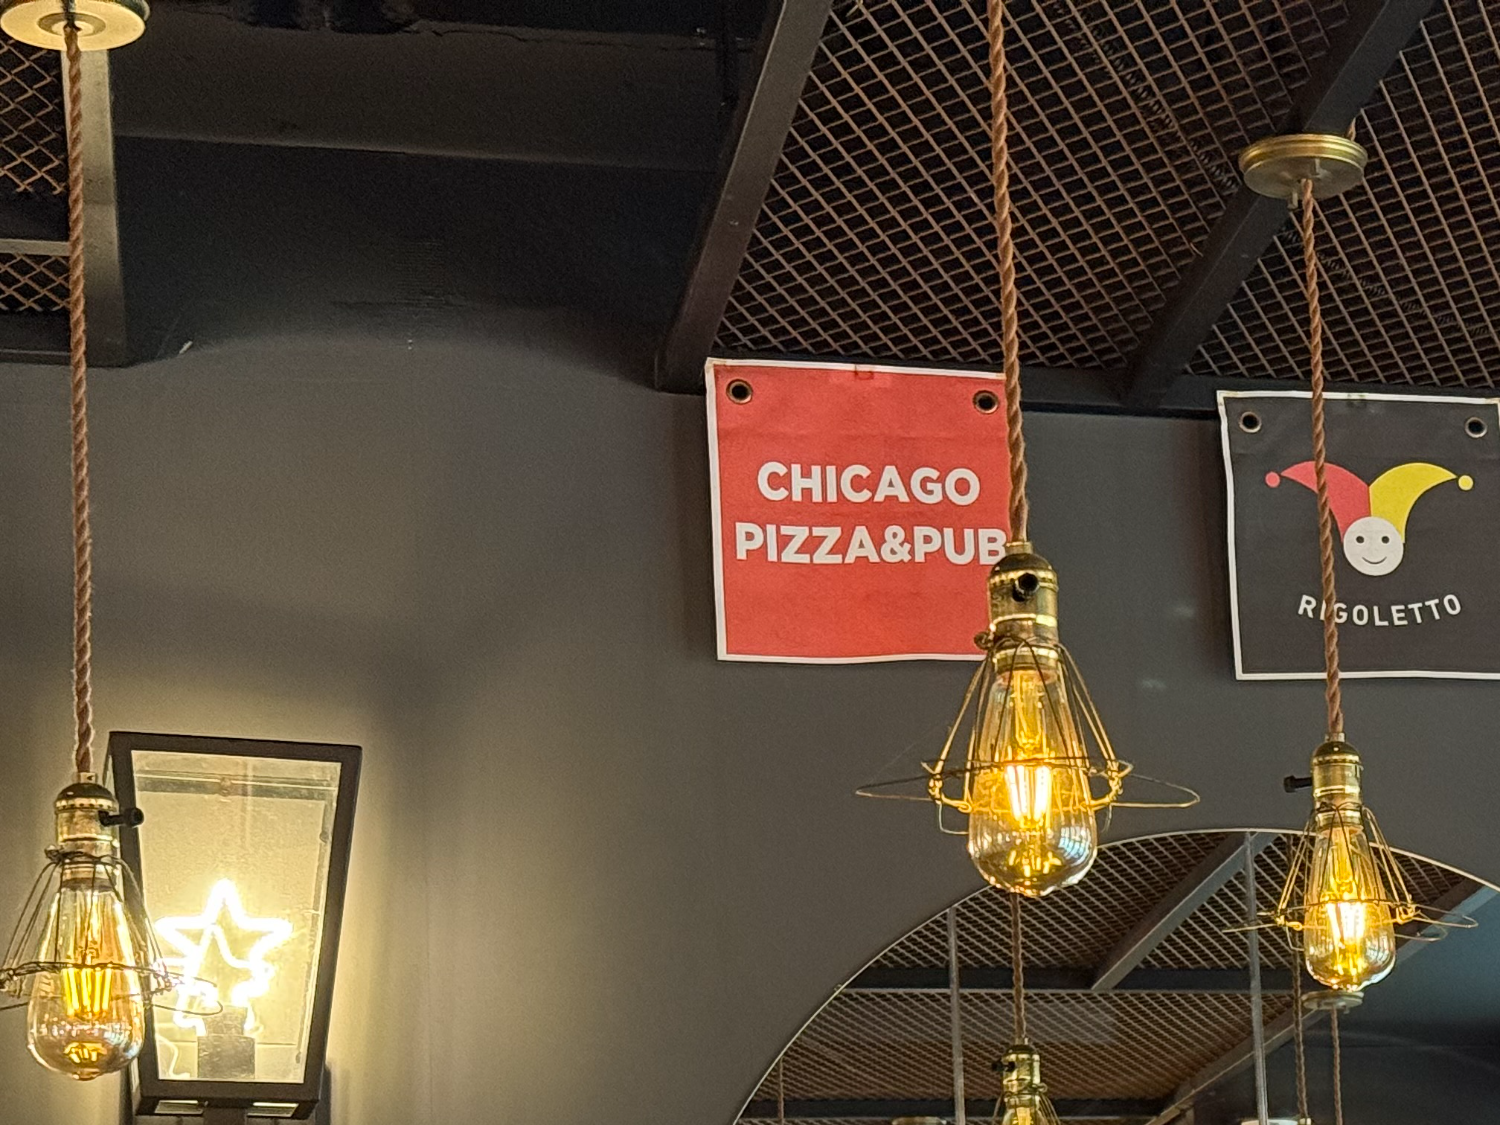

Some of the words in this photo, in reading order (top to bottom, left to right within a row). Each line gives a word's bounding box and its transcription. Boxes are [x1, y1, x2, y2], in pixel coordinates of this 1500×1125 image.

[757, 461, 980, 506] CHICAGO
[734, 522, 1007, 566] PIZZA&PUB
[1297, 593, 1463, 627] RIGOLETTO
